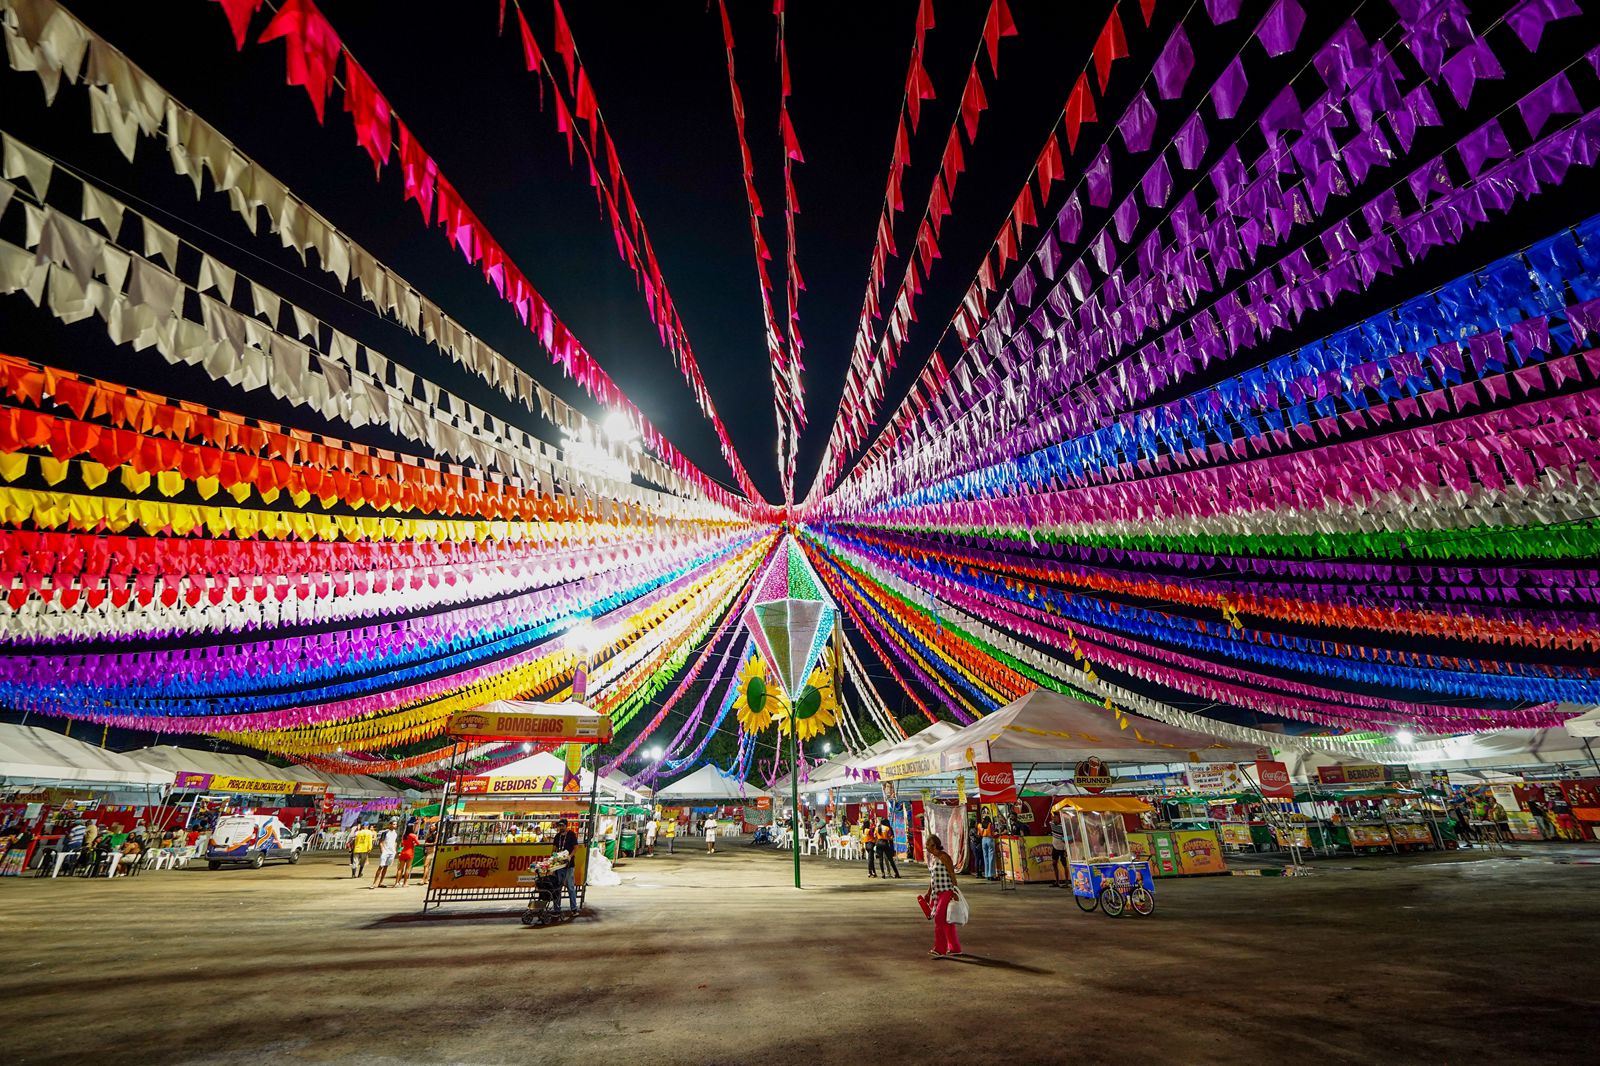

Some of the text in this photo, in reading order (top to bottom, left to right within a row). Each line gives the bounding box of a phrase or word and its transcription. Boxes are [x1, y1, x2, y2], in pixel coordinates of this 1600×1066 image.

[496, 717, 564, 733] BOMBEIROS
[1347, 769, 1380, 779] BEBIDAS
[227, 779, 245, 790] PRAÇA
[245, 781, 255, 789] DE
[493, 779, 538, 792] BEBIDAS
